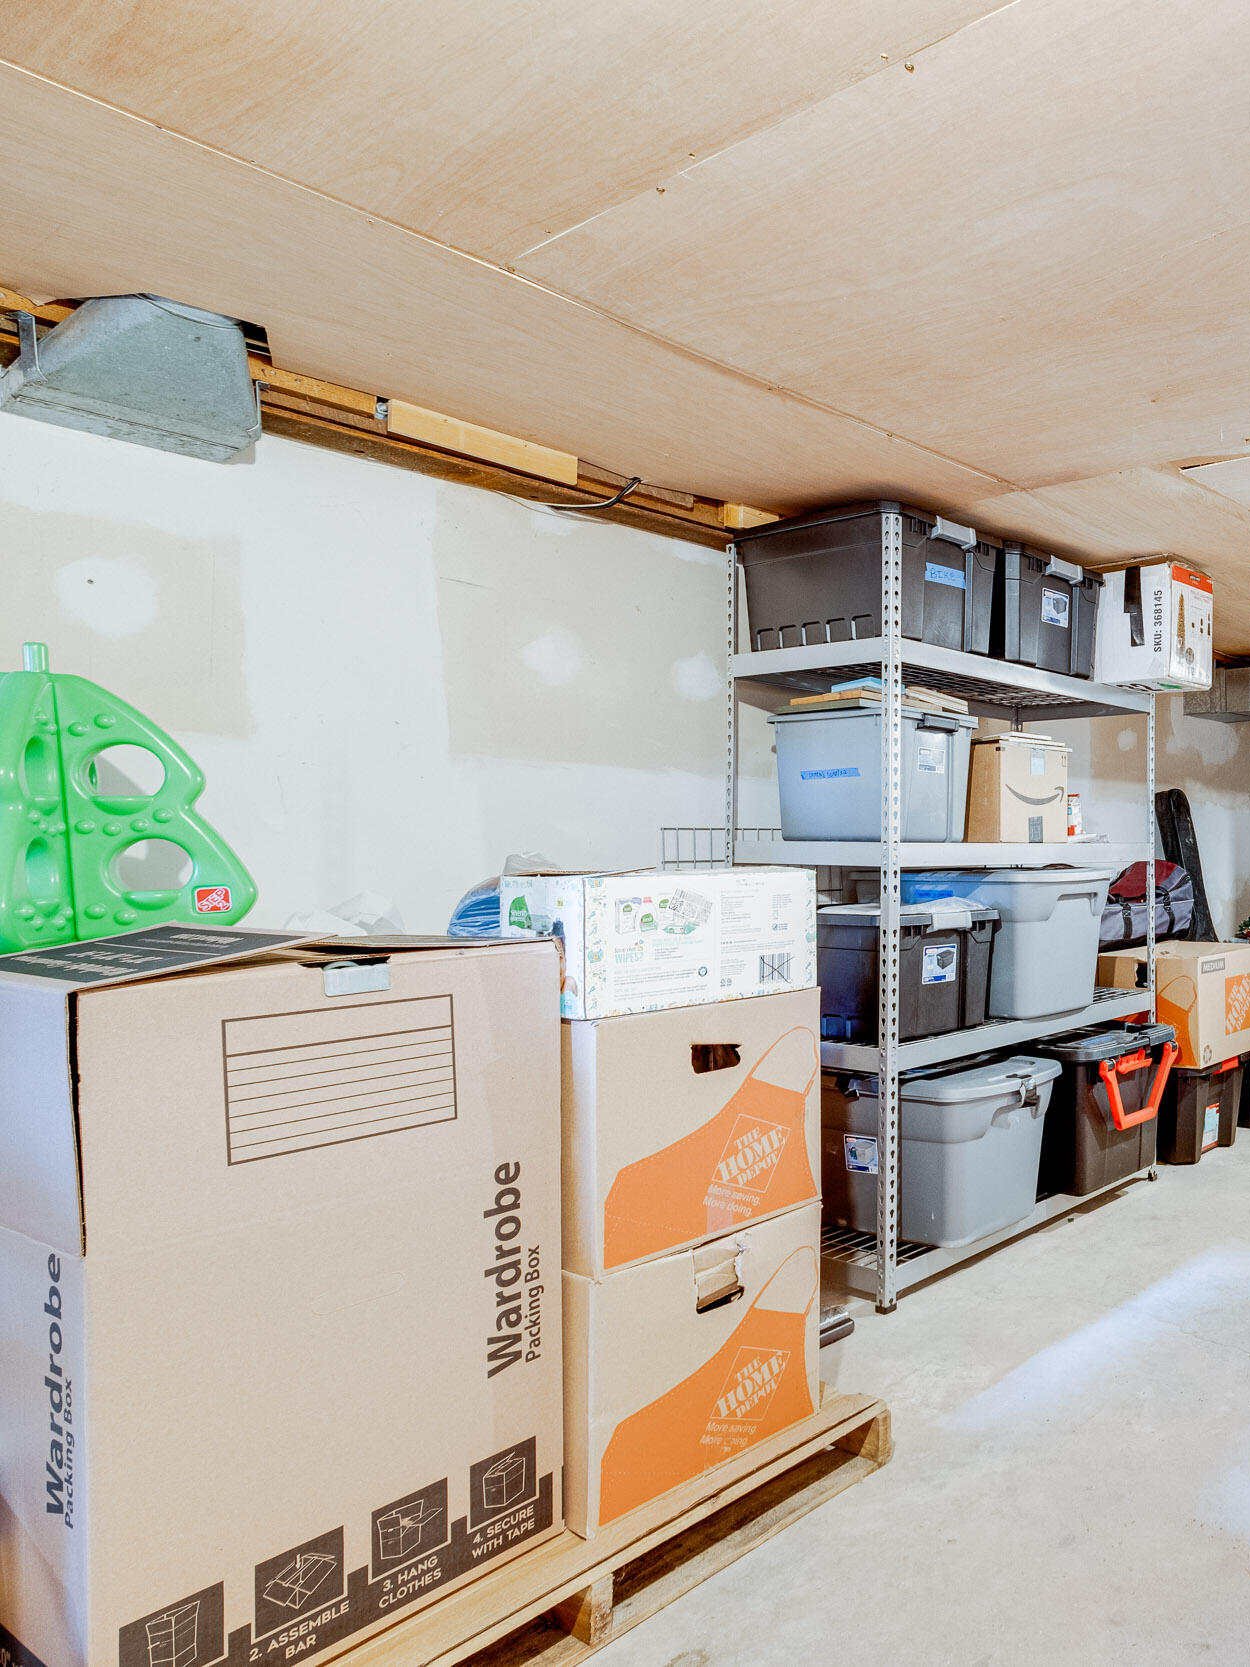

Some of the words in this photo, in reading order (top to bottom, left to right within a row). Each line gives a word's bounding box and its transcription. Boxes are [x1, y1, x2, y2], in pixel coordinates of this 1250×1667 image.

[1153, 589, 1163, 627] 368145
[1153, 630, 1163, 653] SKU:
[198, 888, 226, 912] STEP
[1202, 960, 1225, 973] MEDIUM
[1225, 974, 1250, 1037] HOME
[717, 1125, 787, 1181] HOME
[734, 1126, 761, 1150] THE
[736, 1151, 778, 1185] DEPOT
[702, 1195, 727, 1209] More
[707, 1183, 732, 1198] More
[483, 1160, 523, 1379] Wardrobe
[524, 1244, 540, 1283] Box
[524, 1284, 545, 1363] Packing
[43, 1253, 64, 1515] Wardrobe
[717, 1350, 786, 1418] HOME
[734, 1356, 762, 1381] THE
[64, 1377, 73, 1425] Box
[736, 1377, 777, 1418] DEPOT
[701, 1434, 723, 1445] More
[706, 1421, 729, 1432] More
[64, 1432, 75, 1529] Packing
[471, 1534, 503, 1559] WITH
[506, 1518, 535, 1541] TAPE
[472, 1532, 484, 1544] 4.
[486, 1504, 534, 1538] SECURE
[378, 1567, 442, 1608] CLOTHES
[382, 1579, 394, 1592] 3.
[397, 1555, 439, 1585] HANG
[249, 1647, 263, 1663] 2.
[266, 1600, 350, 1654] ASSEMBLE
[285, 1634, 317, 1660] BAR
